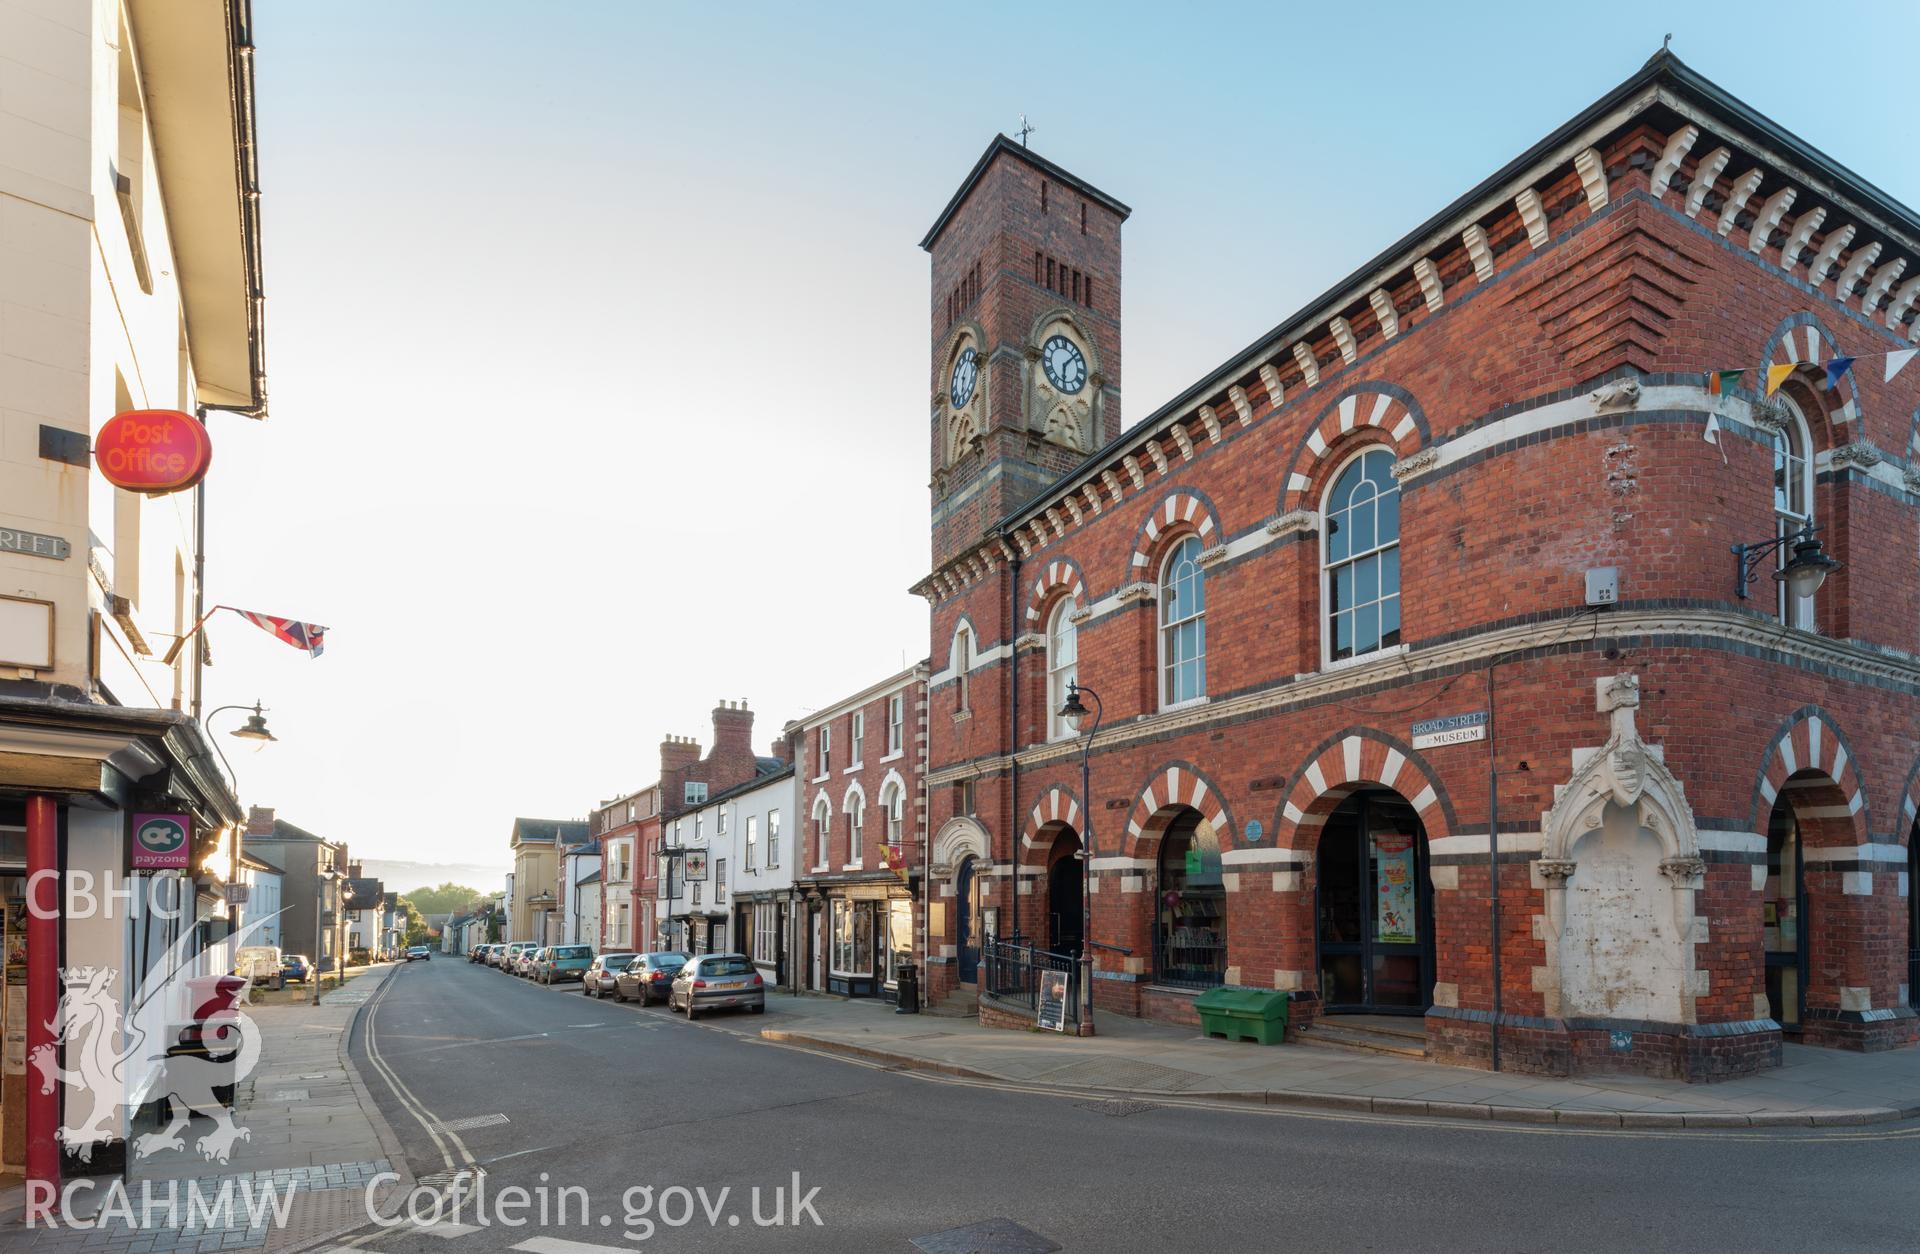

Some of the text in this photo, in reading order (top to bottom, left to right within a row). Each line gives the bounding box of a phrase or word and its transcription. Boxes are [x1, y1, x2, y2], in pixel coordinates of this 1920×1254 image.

[120, 420, 173, 444] Post
[107, 447, 186, 472] Office
[1412, 712, 1485, 734] BROAD STREET
[1433, 729, 1478, 743] MUSEUM
[135, 855, 187, 865] payzone
